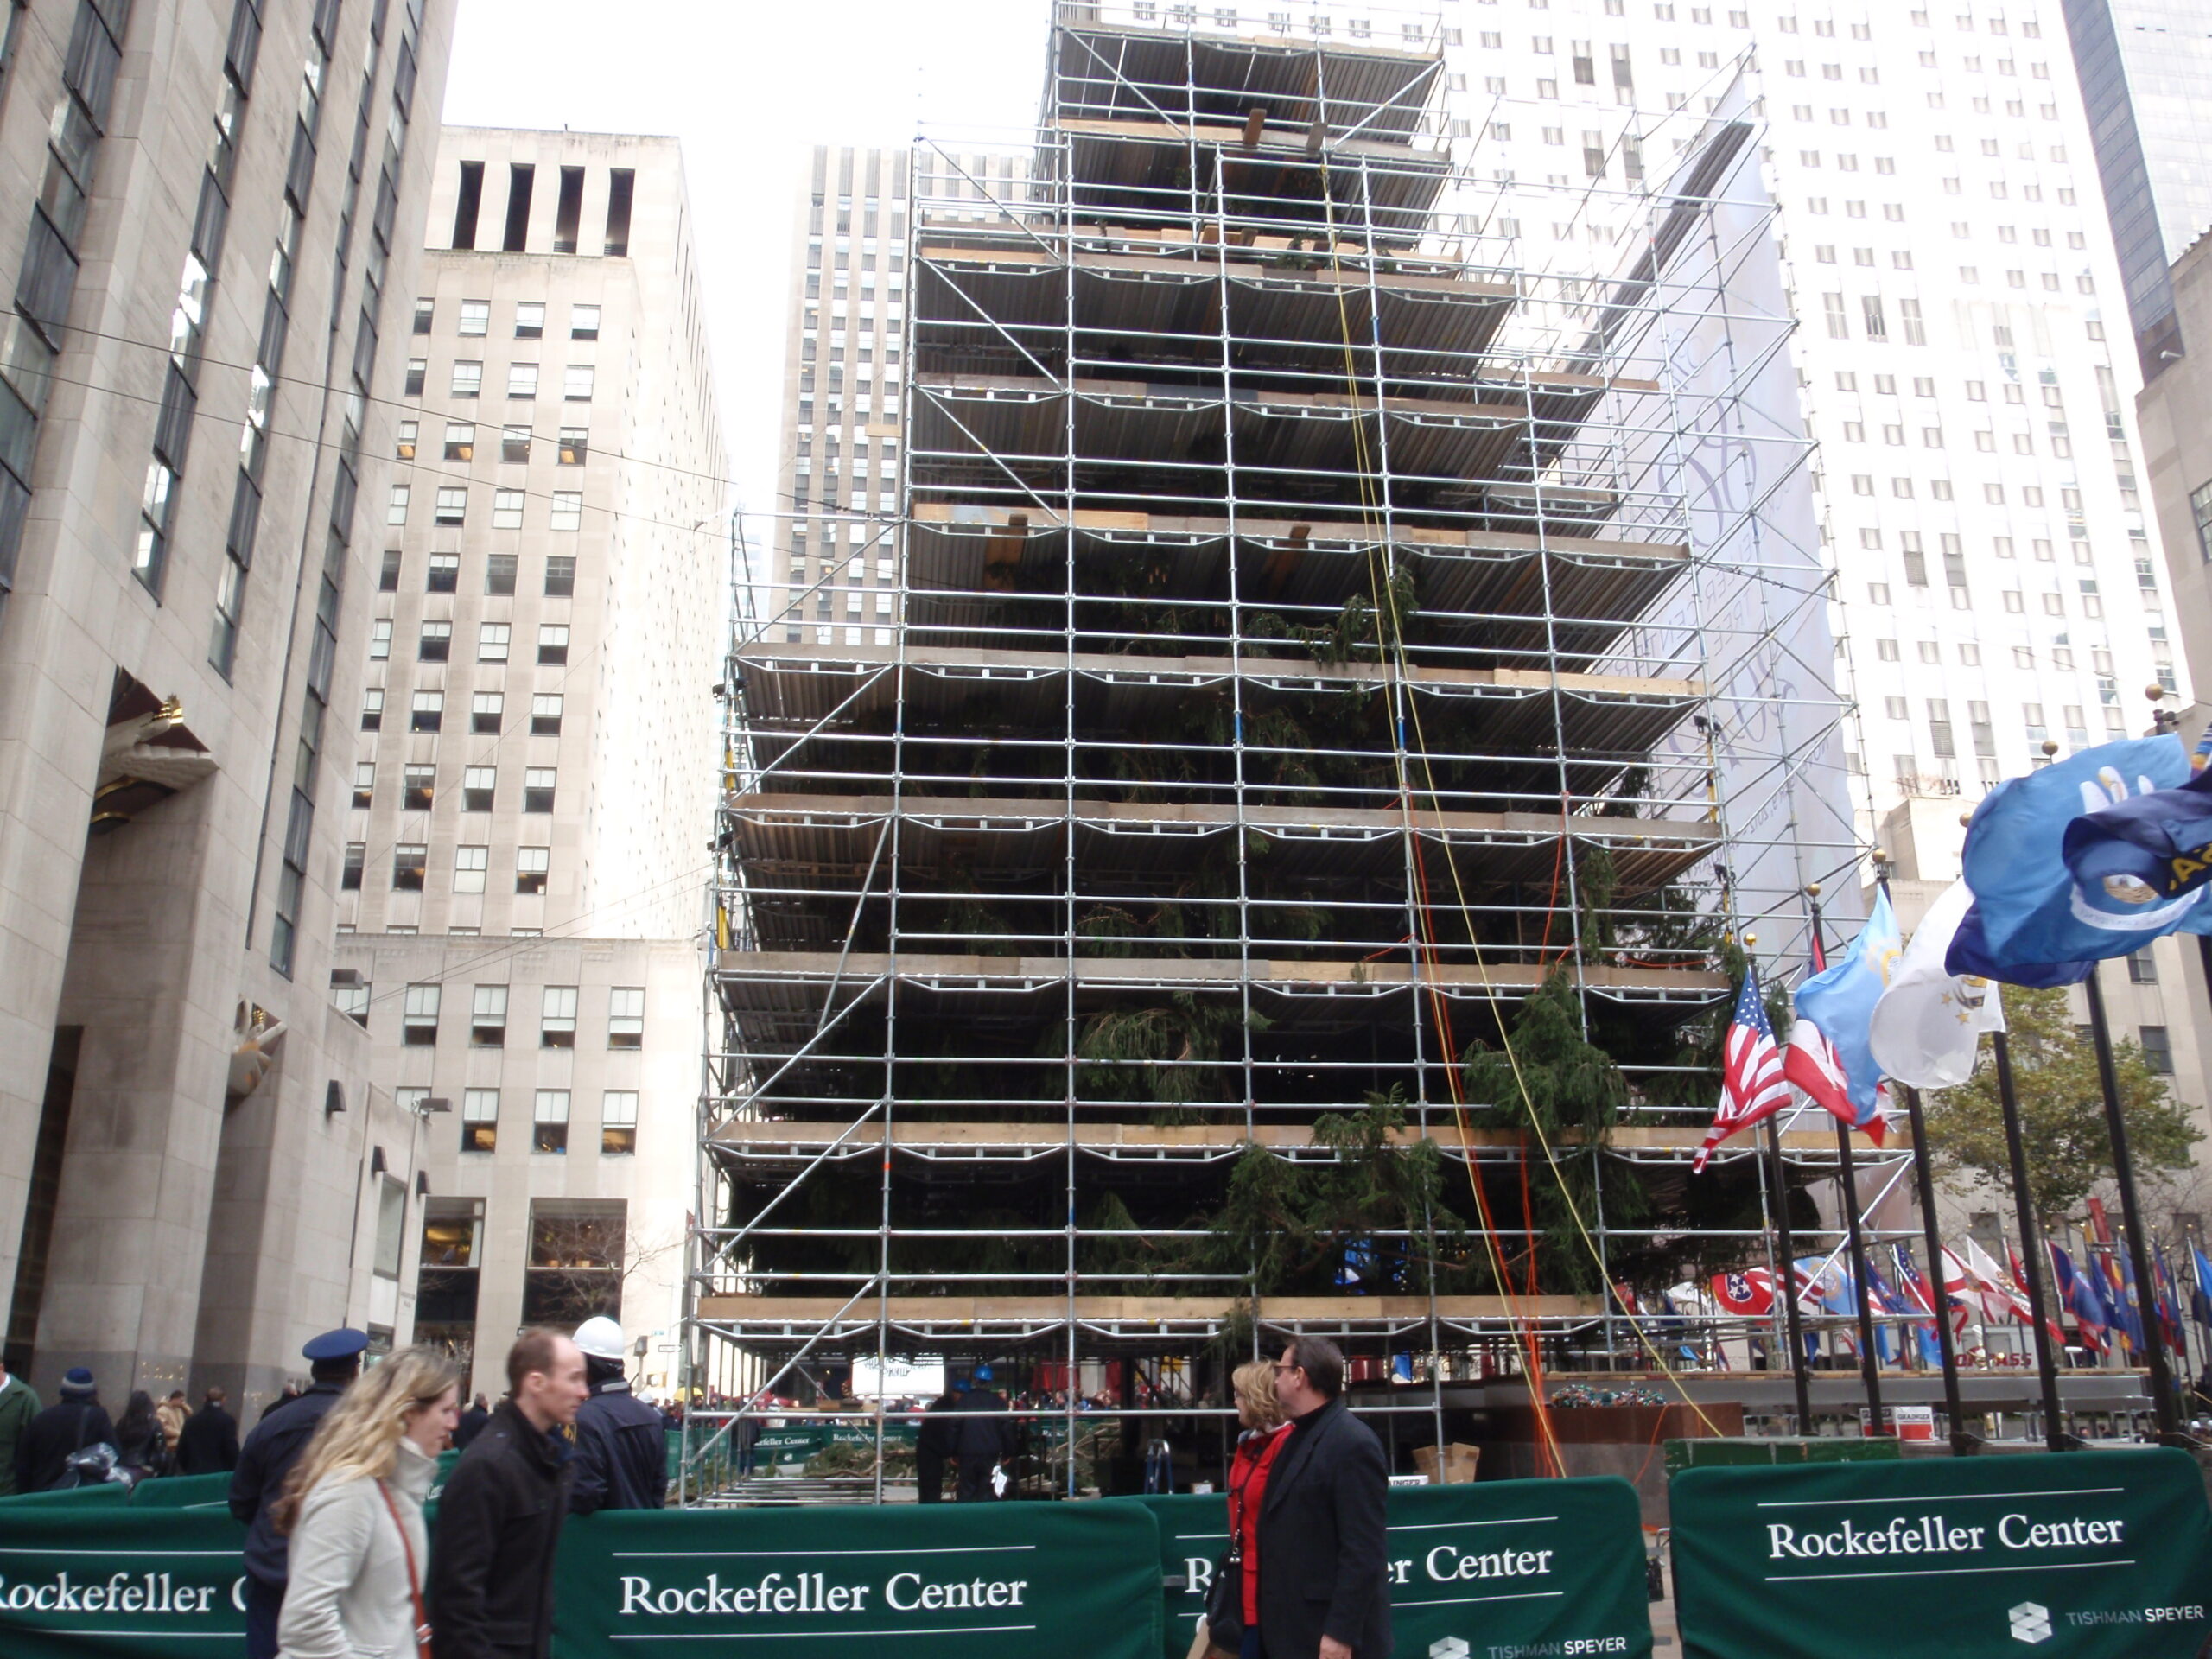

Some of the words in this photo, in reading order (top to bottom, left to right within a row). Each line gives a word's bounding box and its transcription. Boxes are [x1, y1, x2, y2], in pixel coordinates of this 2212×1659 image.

[1767, 1516, 1985, 1558] Rockefeller
[1998, 1514, 2125, 1549] Center
[1426, 1544, 1553, 1582] Center
[619, 1573, 869, 1615] Rockefeller
[885, 1572, 1028, 1611] Center
[2065, 1609, 2142, 1626] TISHMAN
[2145, 1605, 2205, 1624] SPEYER
[1487, 1641, 1560, 1659] TISHMAN
[1563, 1636, 1627, 1656] SPEYER
